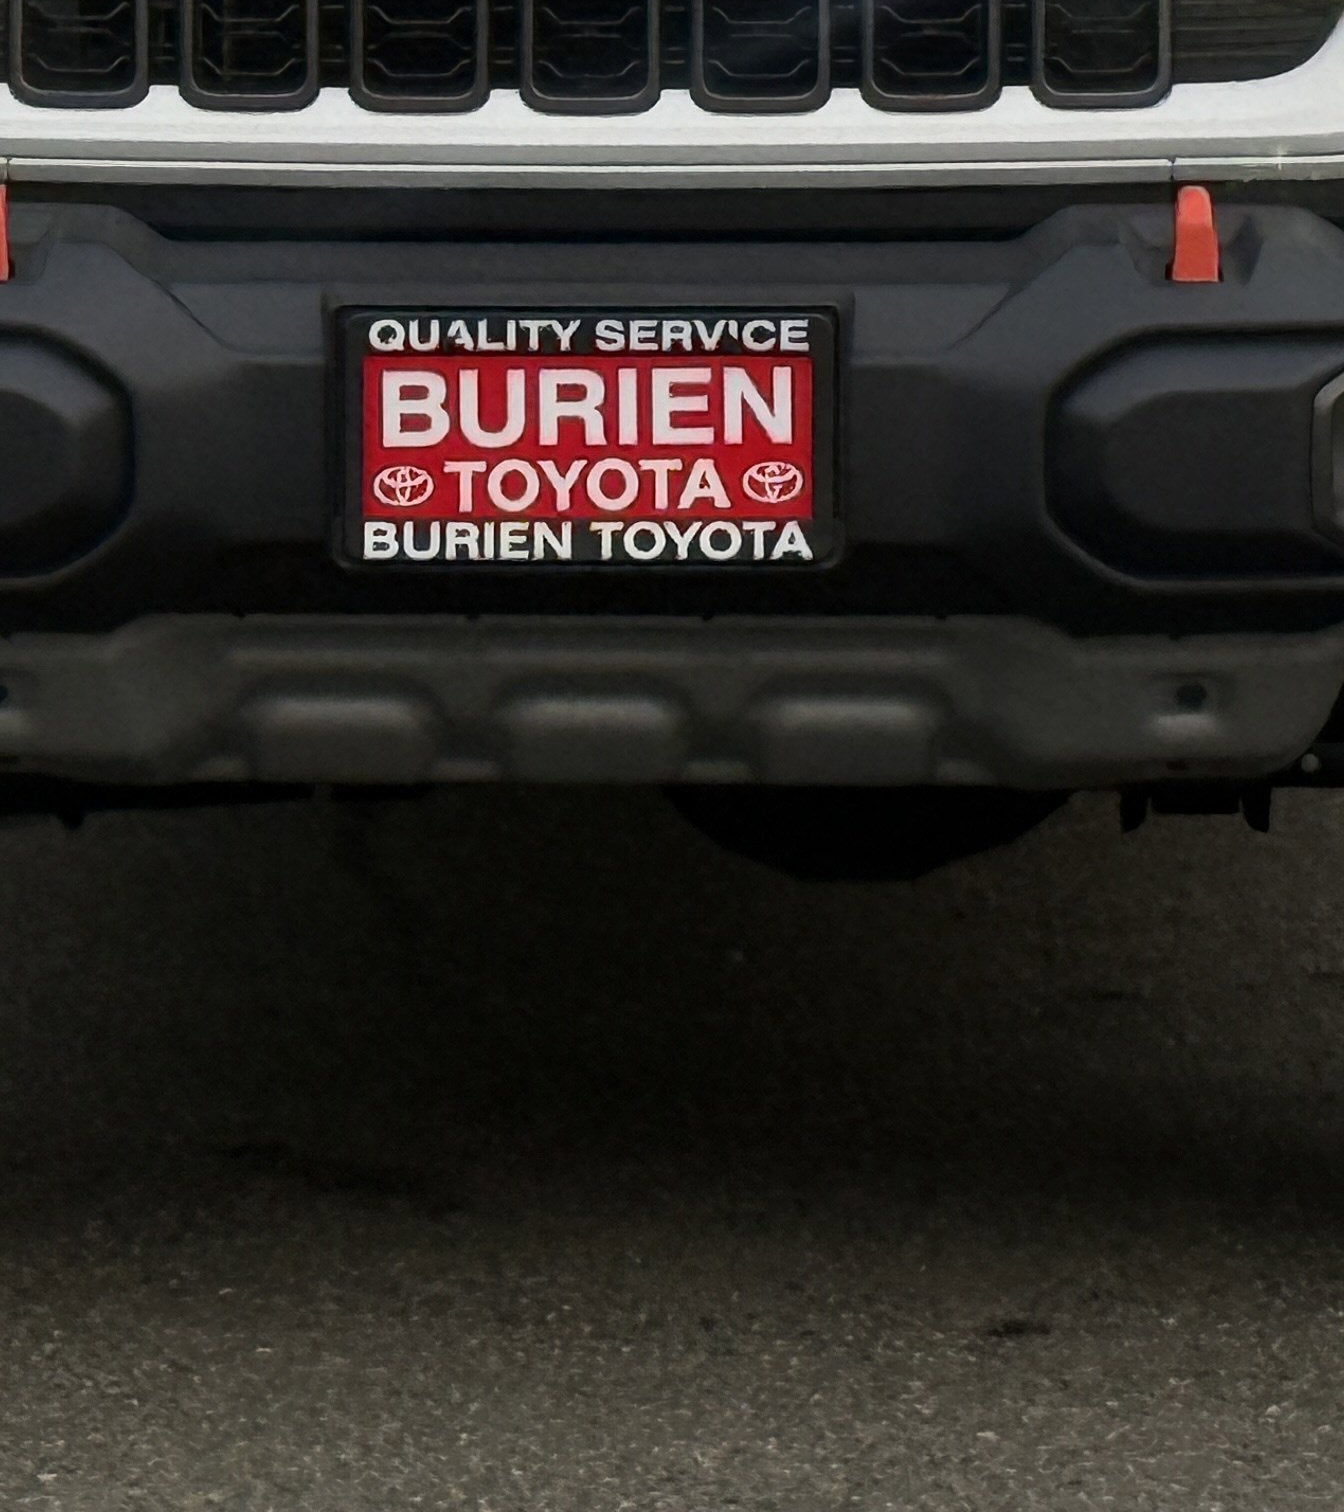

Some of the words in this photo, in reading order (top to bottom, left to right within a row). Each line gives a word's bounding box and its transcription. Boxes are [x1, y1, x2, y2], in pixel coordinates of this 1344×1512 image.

[368, 319, 580, 351] QUALITY
[381, 366, 792, 448] BURIEN
[443, 458, 731, 513] TOYOTA
[363, 520, 572, 560] BURIEN
[589, 520, 813, 560] TOYOTA
